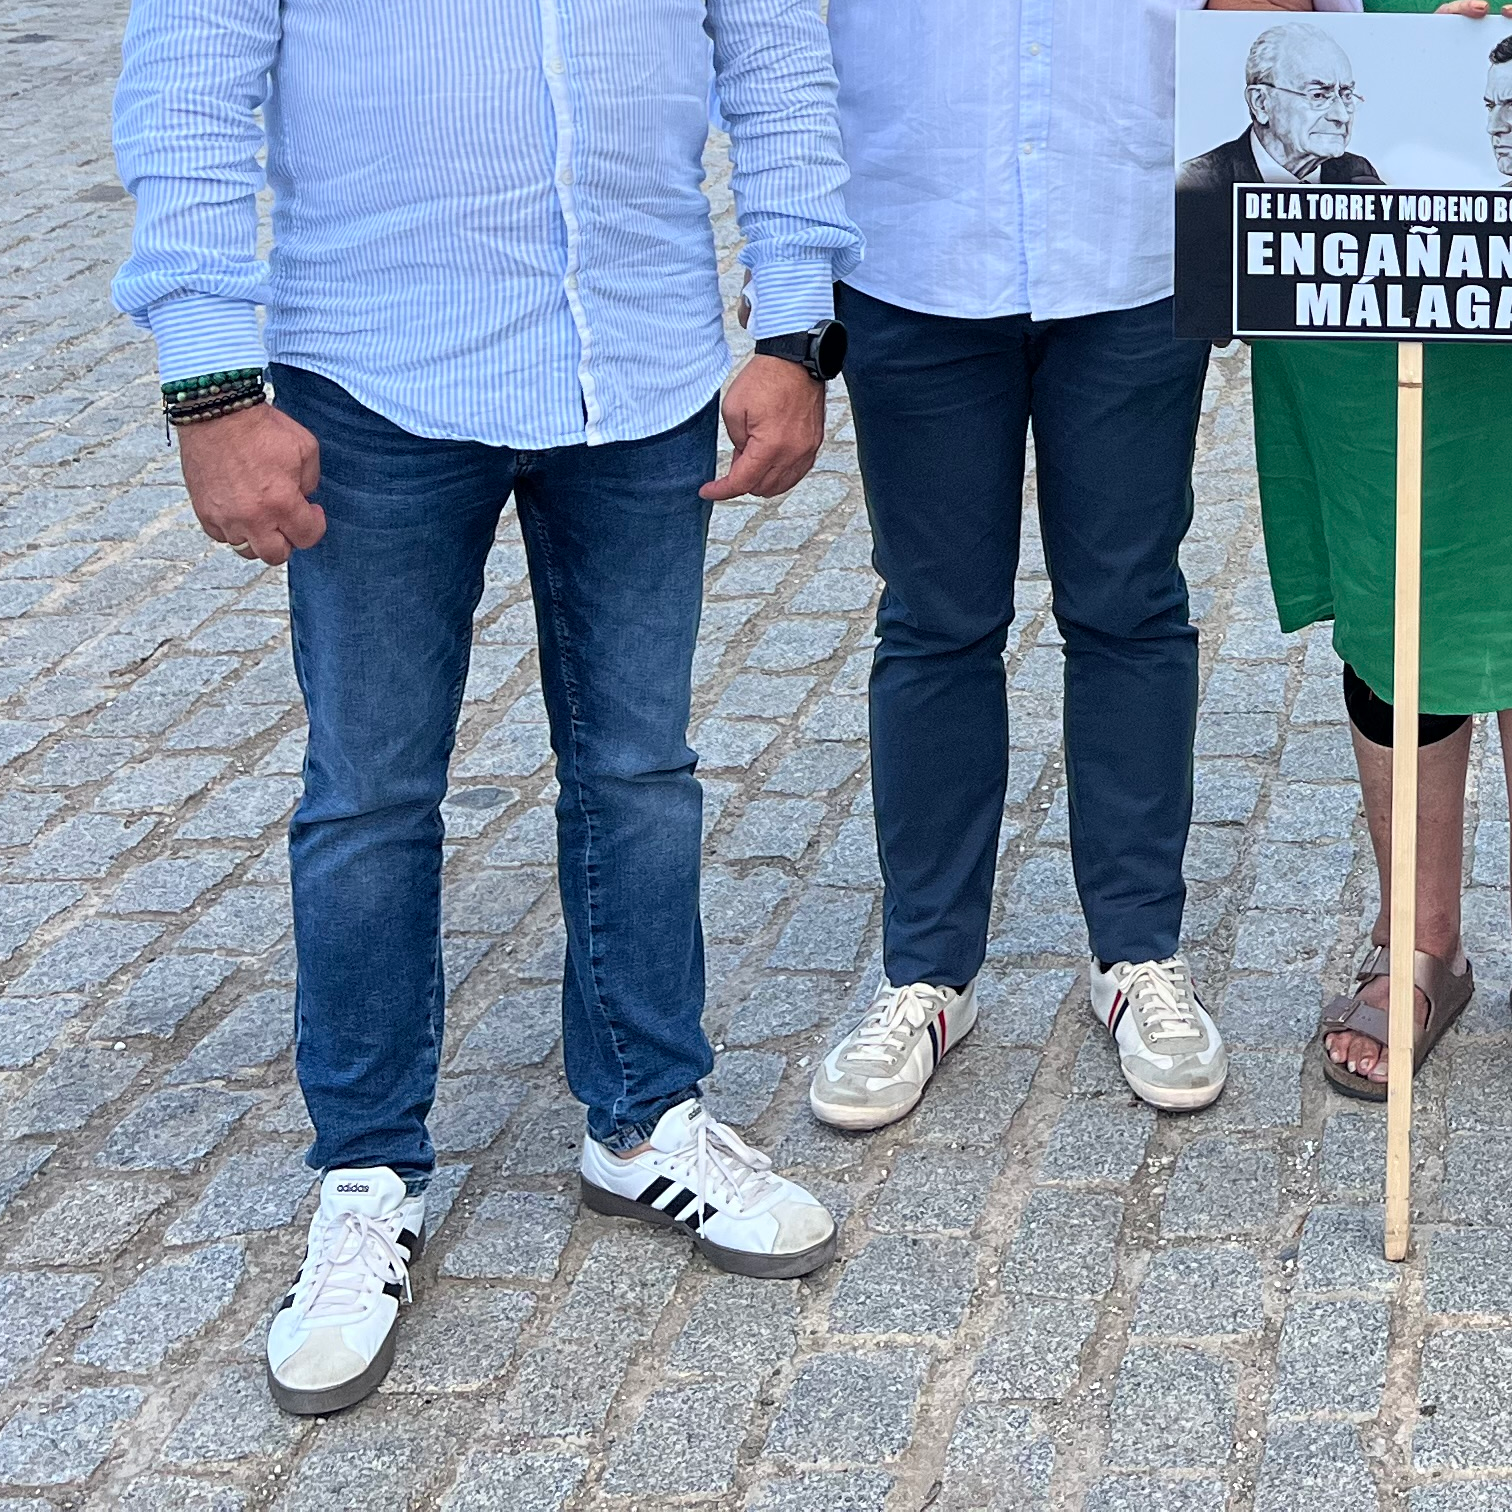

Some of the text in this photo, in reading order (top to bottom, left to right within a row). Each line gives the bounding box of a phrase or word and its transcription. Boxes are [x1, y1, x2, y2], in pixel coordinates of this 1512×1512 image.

[1245, 192, 1272, 219] DE
[1276, 193, 1303, 220] LA
[1306, 193, 1376, 221] TORRE
[1379, 194, 1394, 221] Y
[1398, 195, 1488, 223] MORENO
[336, 1182, 370, 1193] adidas
